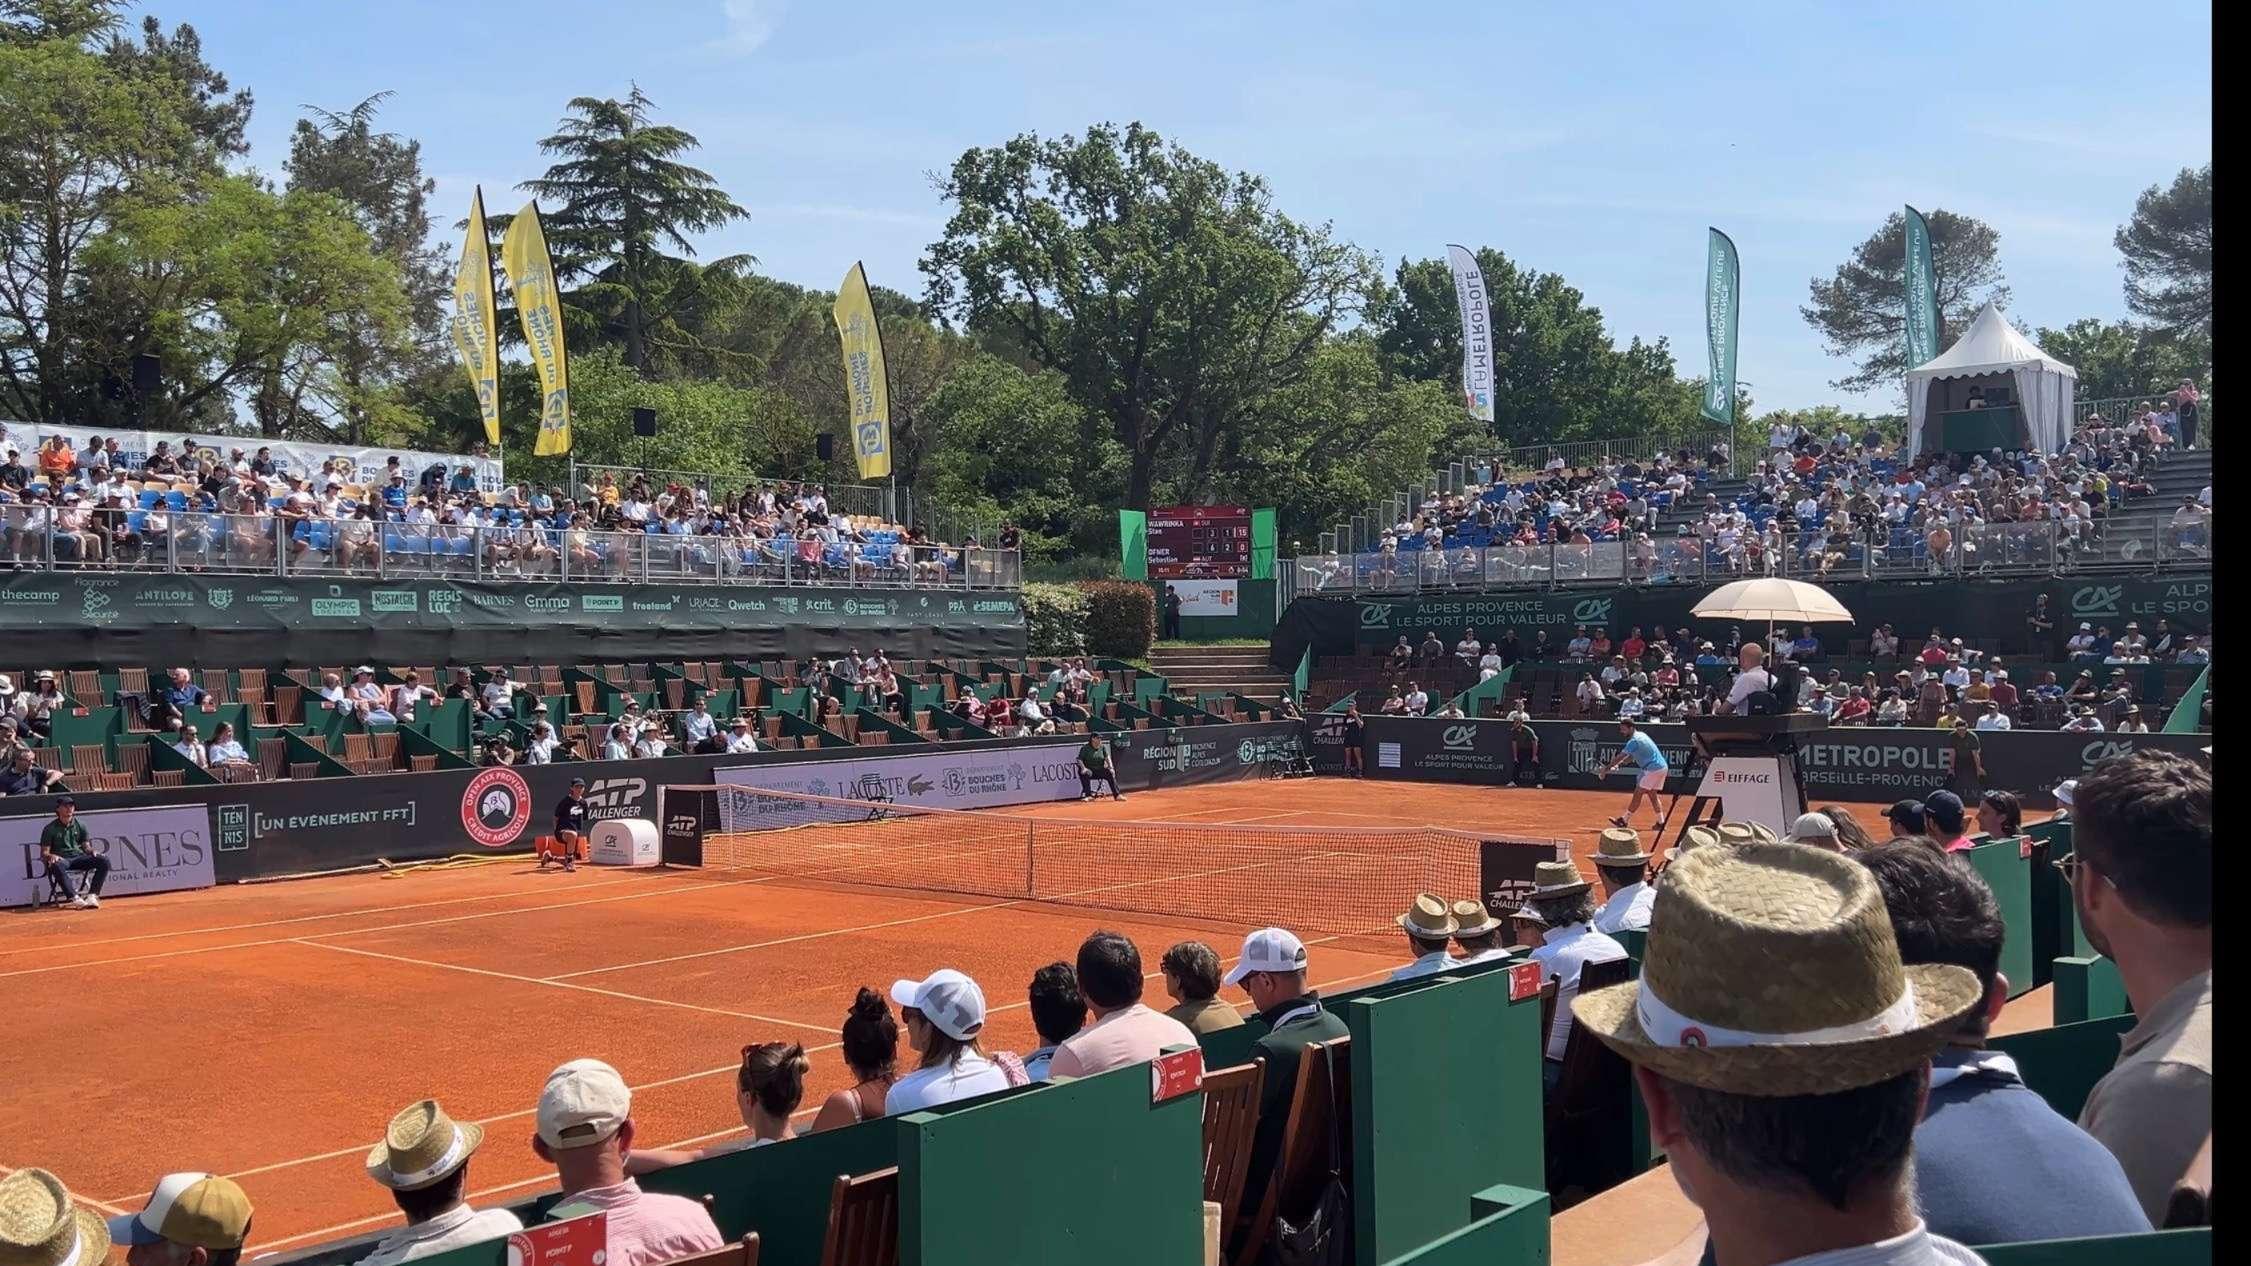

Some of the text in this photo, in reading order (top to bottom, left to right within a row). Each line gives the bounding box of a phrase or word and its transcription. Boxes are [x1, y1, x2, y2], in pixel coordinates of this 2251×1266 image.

[2, 590, 60, 602] thecamp
[2166, 584, 2211, 597] ALP
[315, 600, 356, 610] OLYMPIC
[728, 600, 766, 610] Qwetch
[1417, 601, 1543, 614] ALPES PROVENCE
[2132, 600, 2209, 614] LE SPO
[1396, 614, 1566, 627] LE SPORT POUR VALEUR
[1144, 746, 1176, 760] RÉGION
[1452, 754, 1494, 762] PROVENCE
[1600, 748, 1616, 762] AIX
[1158, 758, 1176, 770] SUD
[1032, 762, 1079, 782] LACOST
[968, 774, 1005, 784] BOUCHES
[1728, 774, 1770, 784] EIFFAGE
[466, 772, 527, 806] OPEN AIX PROVENCE
[969, 783, 1006, 794] DU RHÔNE
[224, 812, 244, 824] TEN
[288, 810, 378, 828] ÉVÉNEMENT
[492, 814, 526, 841] AGRICOLE
[224, 830, 244, 844] NIS
[19, 830, 204, 881] BRNES
[143, 869, 178, 880] REALTY
